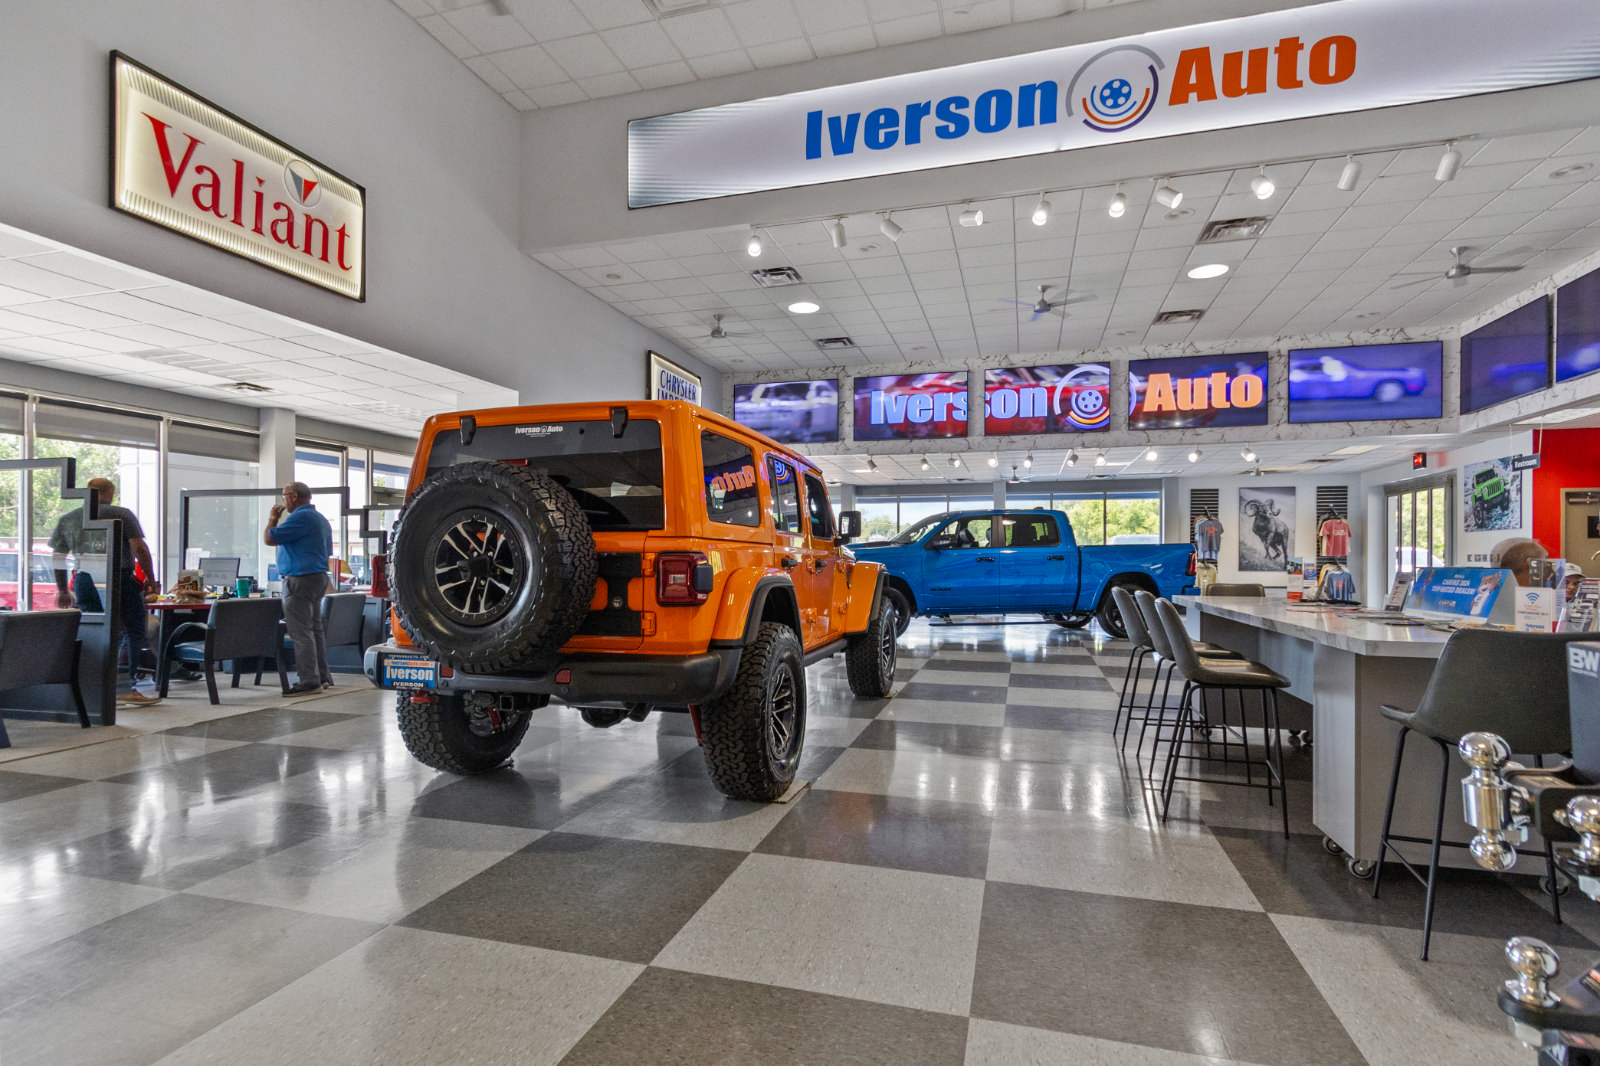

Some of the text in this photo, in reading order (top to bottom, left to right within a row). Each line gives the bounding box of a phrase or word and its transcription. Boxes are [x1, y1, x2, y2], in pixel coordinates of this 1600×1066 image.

[805, 35, 1356, 160] Iverson Auto
[141, 111, 352, 271] Valiant
[660, 369, 697, 402] CHRYSLER
[1142, 371, 1264, 412] Auto
[386, 666, 433, 681] Iverson
